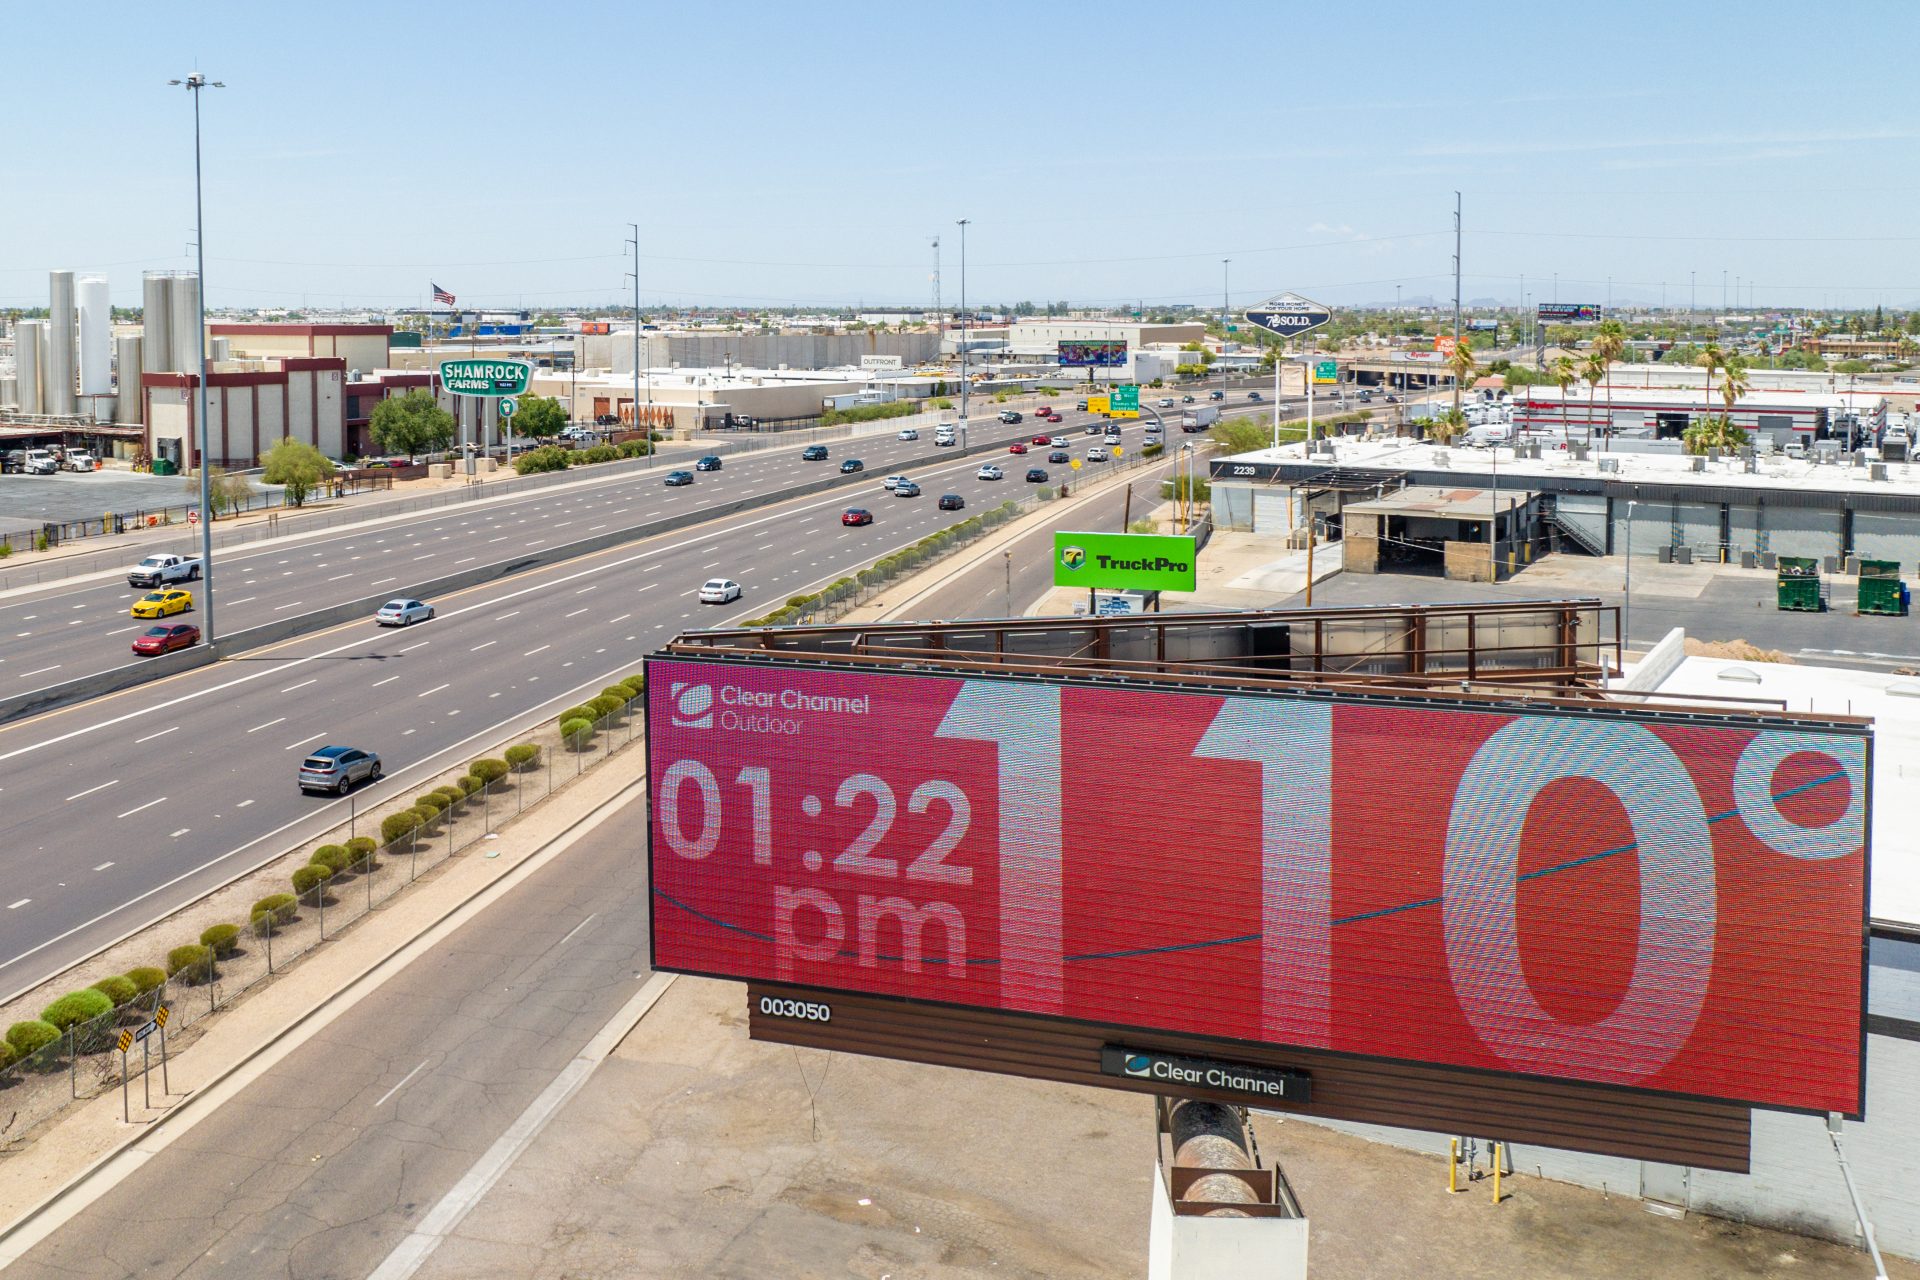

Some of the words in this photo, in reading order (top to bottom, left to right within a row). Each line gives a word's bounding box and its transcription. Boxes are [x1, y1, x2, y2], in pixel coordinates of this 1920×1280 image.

[863, 358, 897, 366] OUTFRONT
[1410, 351, 1431, 359] Ryder
[445, 364, 525, 380] SHAMROCK
[448, 379, 490, 389] FARMS
[1233, 466, 1256, 476] 2239
[1096, 555, 1188, 573] TruckPro
[721, 685, 775, 709] Clear
[781, 689, 870, 714] Channel
[721, 710, 804, 735] Outdoor
[659, 759, 974, 886] 01:22
[774, 886, 967, 982] pm
[760, 997, 831, 1022] 003050
[1153, 1061, 1203, 1083] Clear
[1206, 1069, 1285, 1096] Channel
